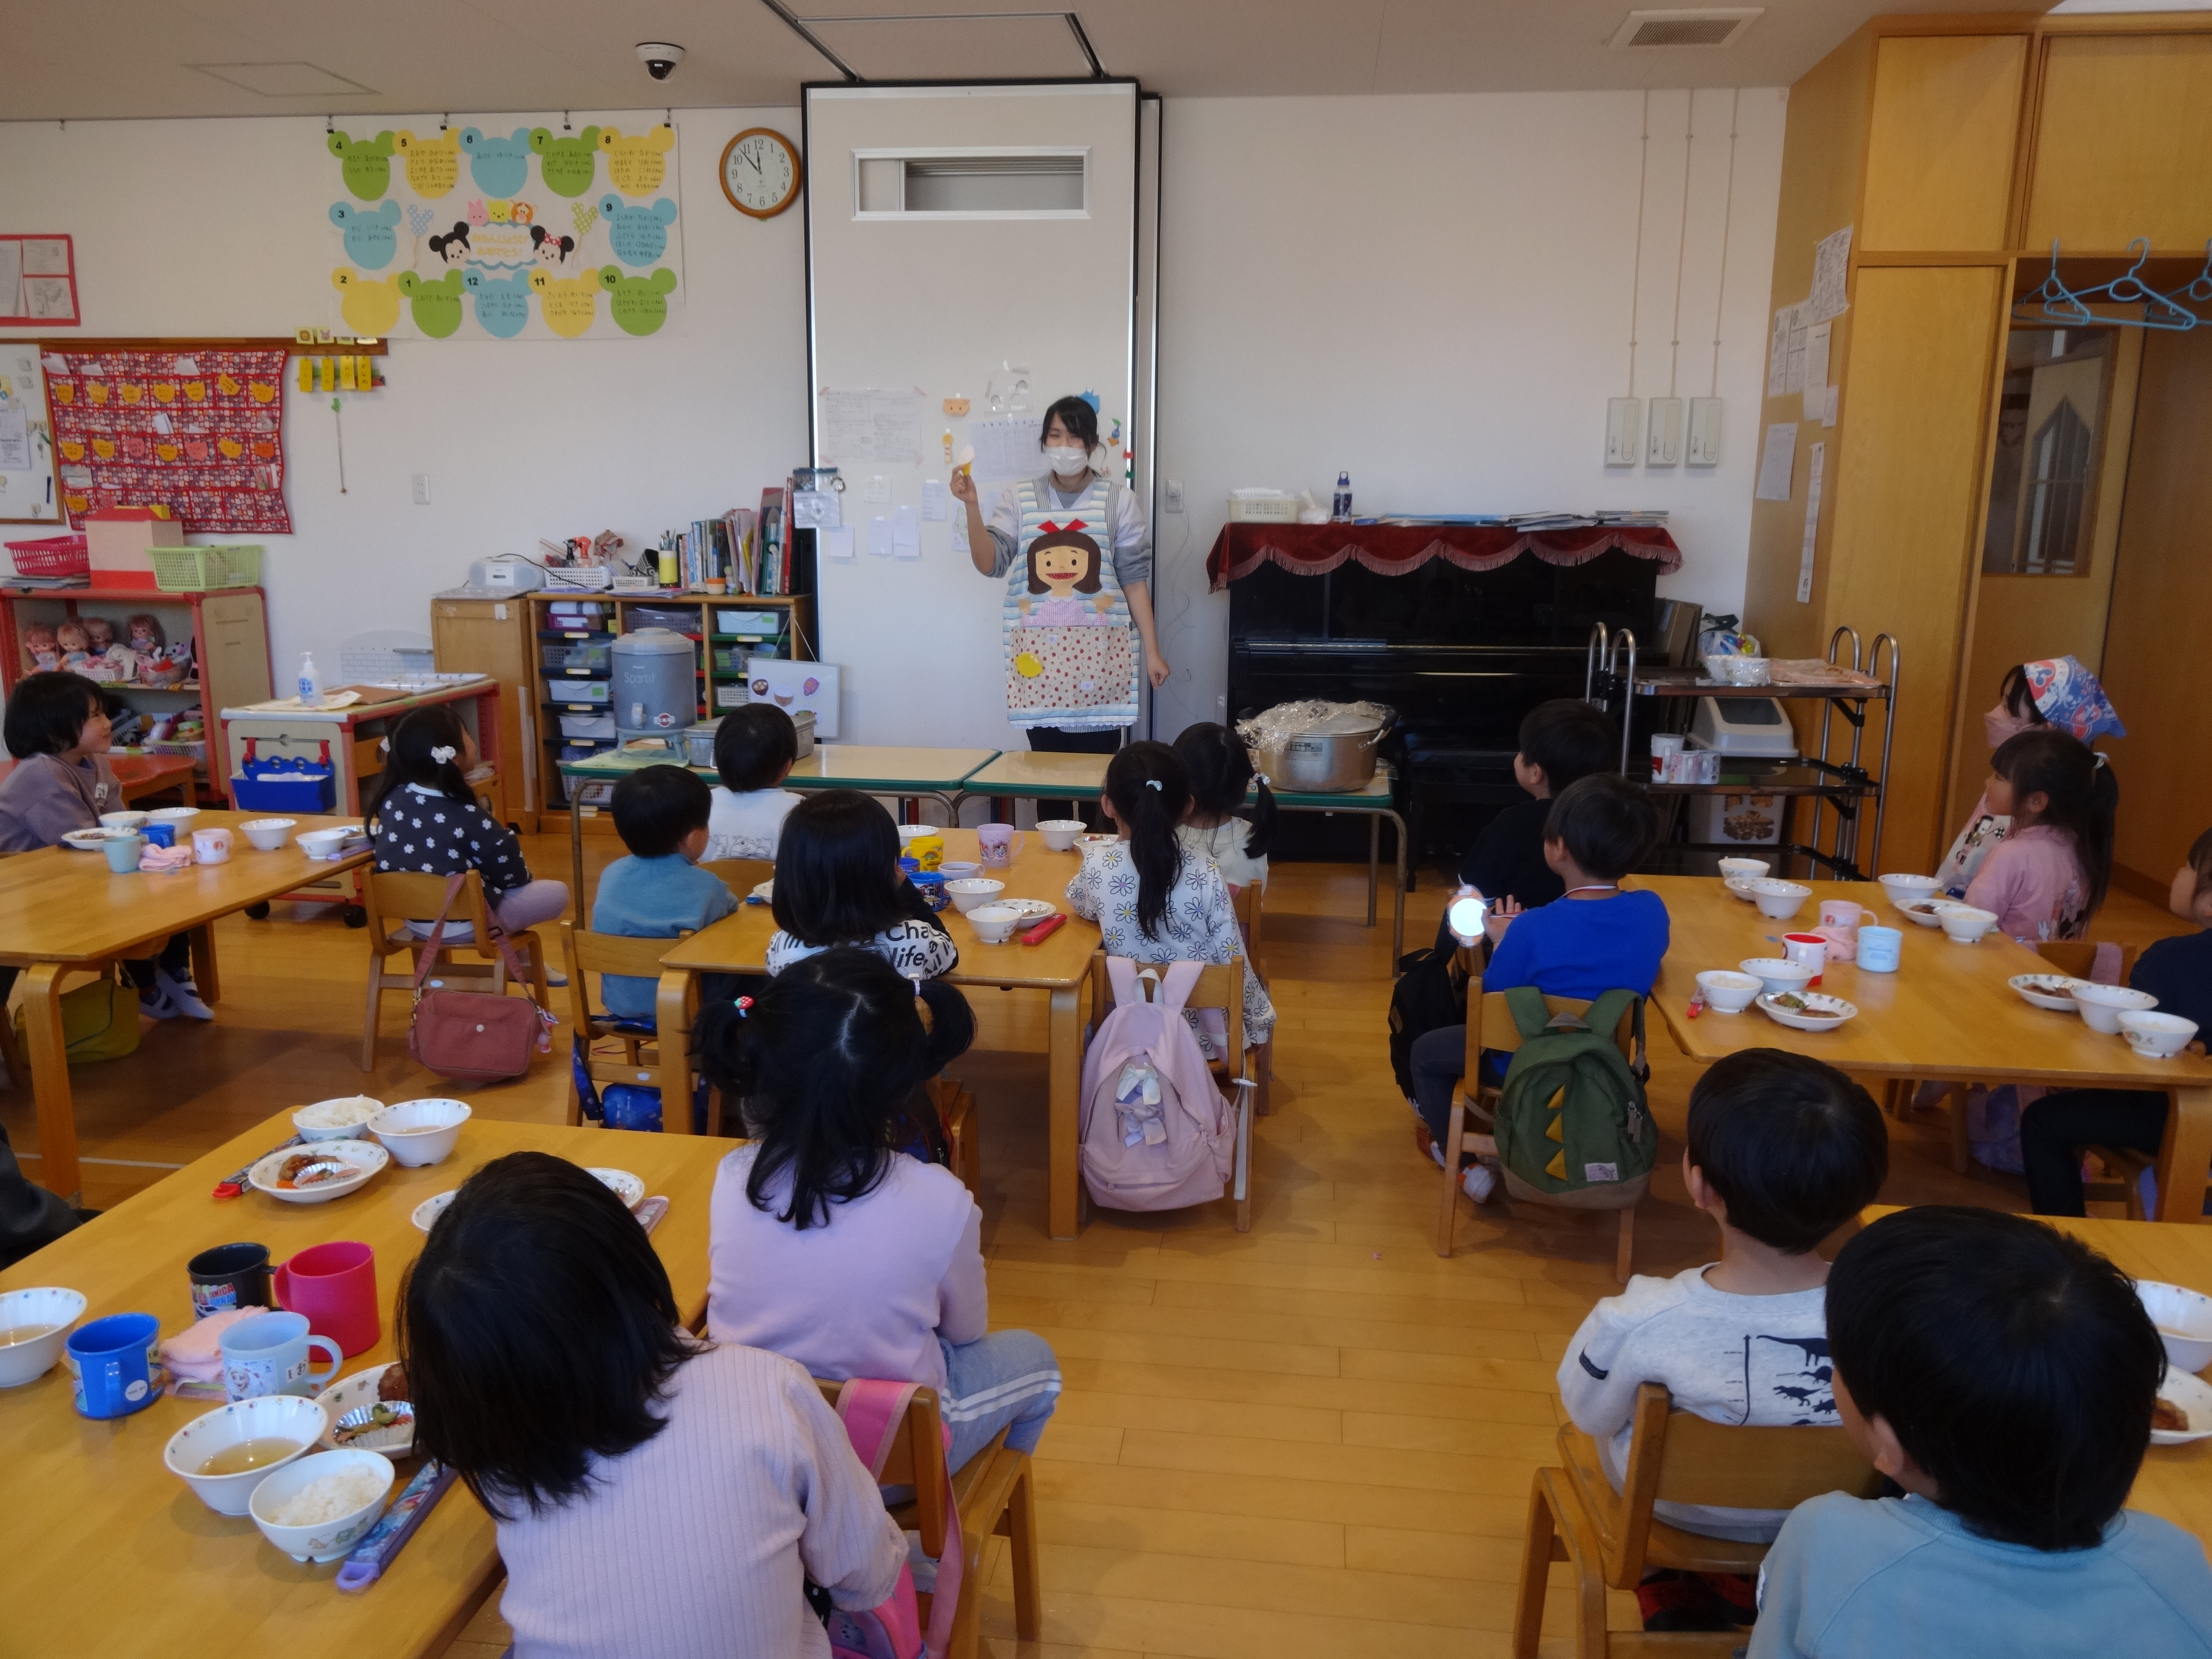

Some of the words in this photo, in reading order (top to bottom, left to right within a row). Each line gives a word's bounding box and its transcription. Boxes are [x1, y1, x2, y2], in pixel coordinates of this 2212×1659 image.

[401, 138, 407, 147] 5
[466, 135, 473, 144] 6
[537, 136, 543, 144] 7
[605, 135, 611, 144] 8
[754, 139, 764, 150] 12
[336, 141, 342, 150] 4
[743, 144, 751, 154] 11
[770, 142, 774, 153] 1
[734, 154, 743, 165] 10
[779, 152, 785, 163] 2
[731, 169, 737, 179] 9
[783, 166, 789, 177] 3
[737, 183, 743, 193] 8
[780, 181, 786, 191] 4
[747, 193, 752, 203] 7
[759, 196, 765, 206] 6
[772, 192, 777, 203] 5
[606, 203, 612, 212] 9
[338, 210, 344, 218] 3
[340, 275, 347, 284] 2
[406, 279, 411, 287] 1
[467, 277, 478, 286] 12
[534, 276, 545, 286] 11
[605, 275, 616, 283] 10
[624, 672, 655, 684] Sportif
